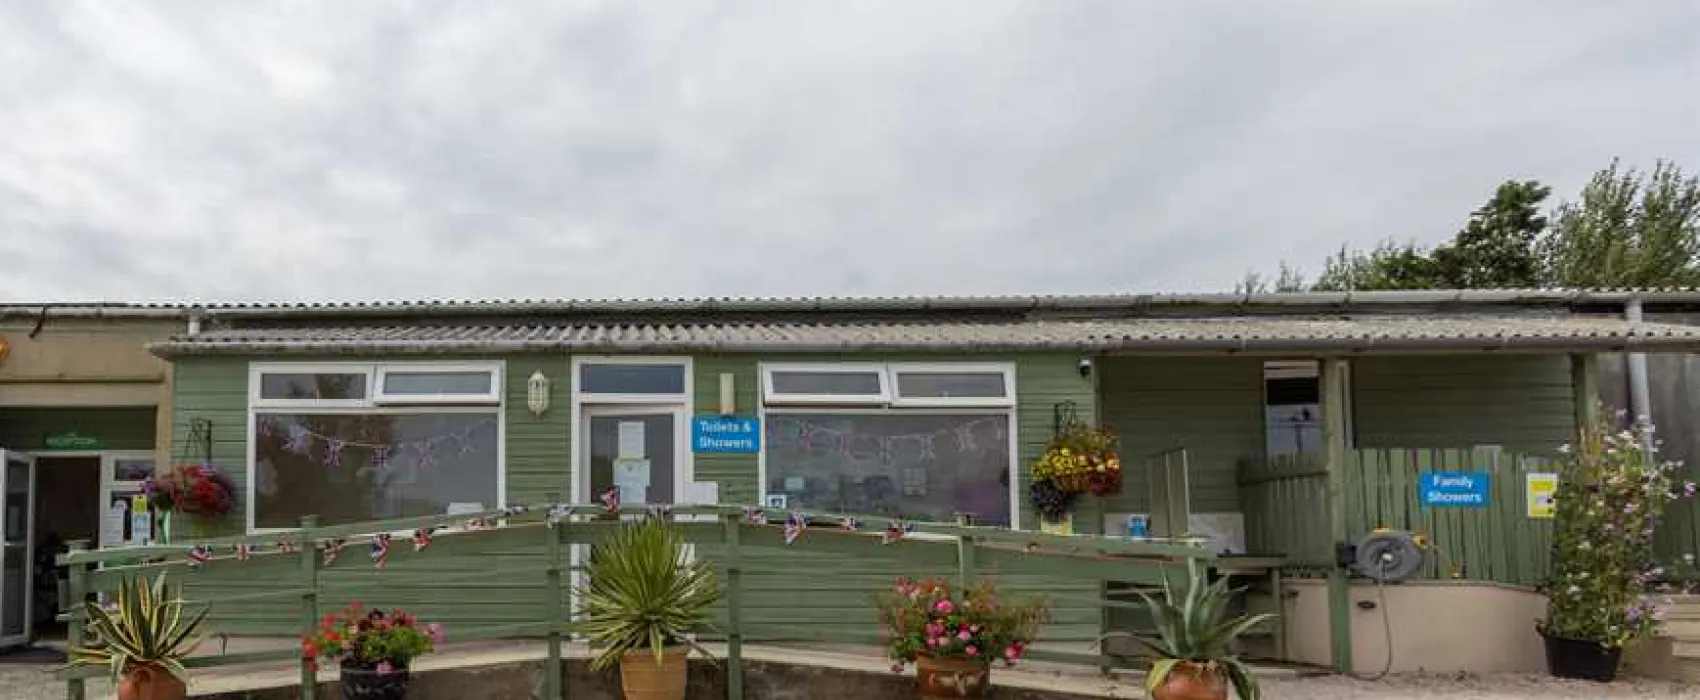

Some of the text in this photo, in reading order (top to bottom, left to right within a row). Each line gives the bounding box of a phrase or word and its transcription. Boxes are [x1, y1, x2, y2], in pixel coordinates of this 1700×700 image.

[699, 420, 752, 433] Toilets &
[699, 437, 752, 449] Showers
[1433, 475, 1472, 489] Family
[1427, 490, 1482, 503] Showers
